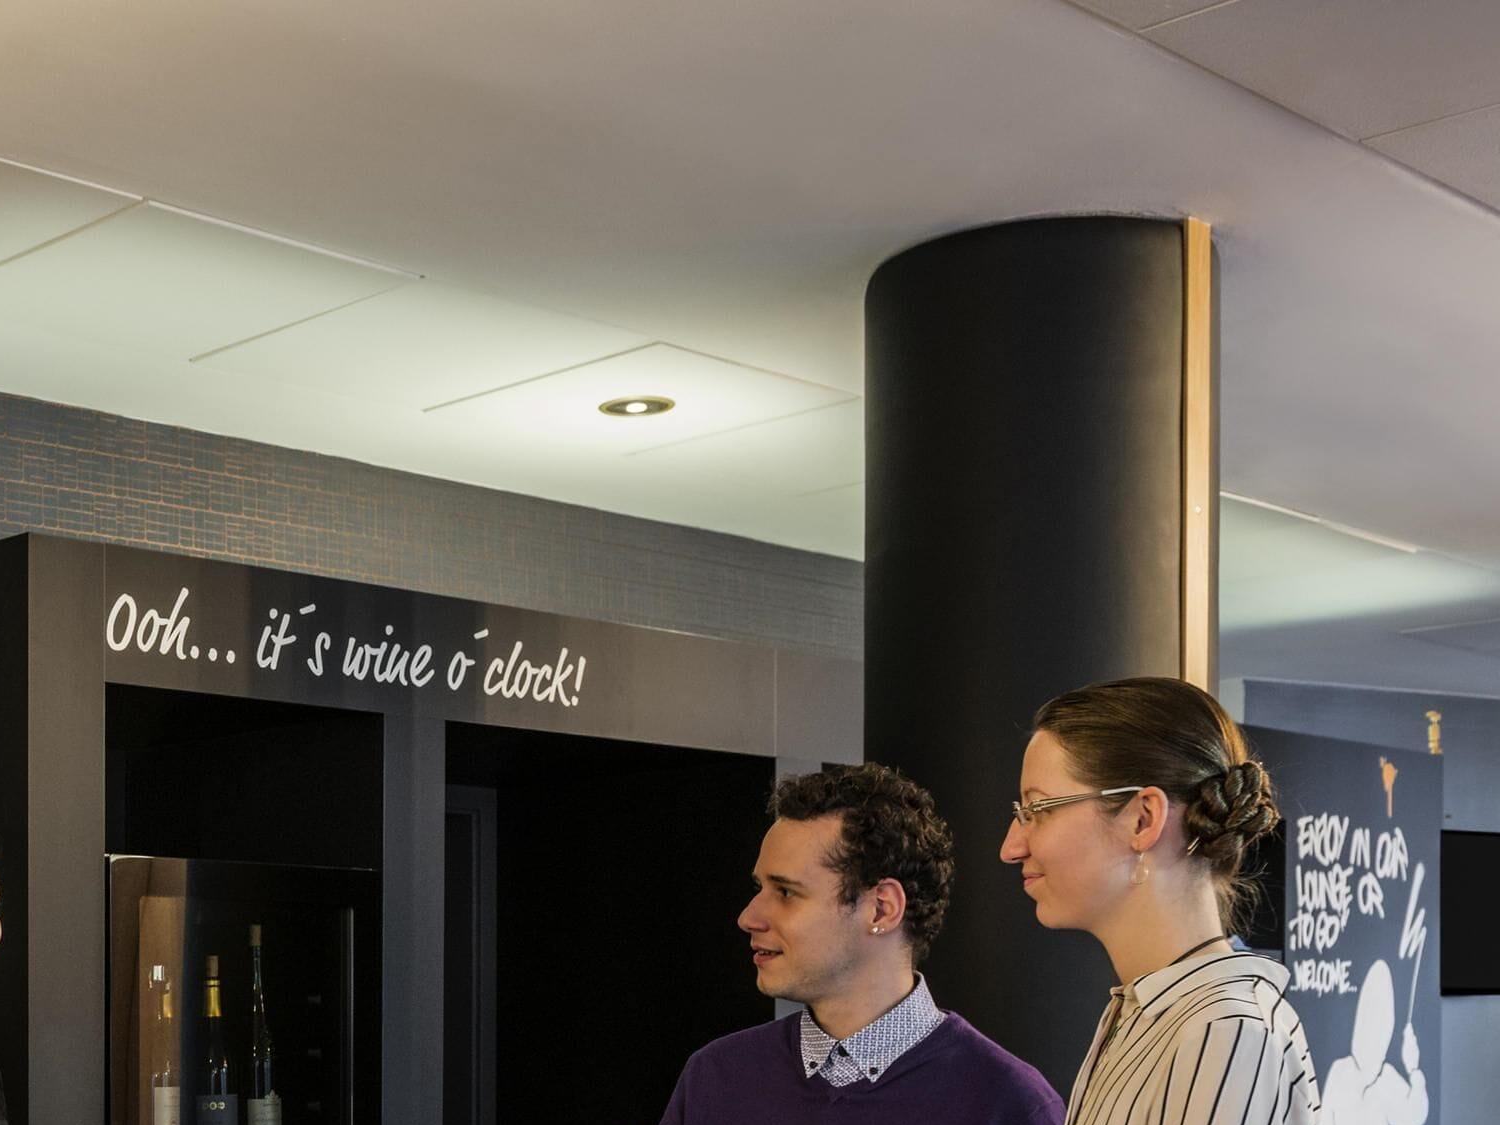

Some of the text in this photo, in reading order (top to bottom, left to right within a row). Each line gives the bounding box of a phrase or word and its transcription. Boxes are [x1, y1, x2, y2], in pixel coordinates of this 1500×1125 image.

[106, 587, 236, 664] Ooh...
[342, 624, 435, 688] wine
[1297, 812, 1409, 882] ENJOY IN OUR
[1295, 863, 1385, 922] LOUNGE OR
[1315, 911, 1341, 954] GO
